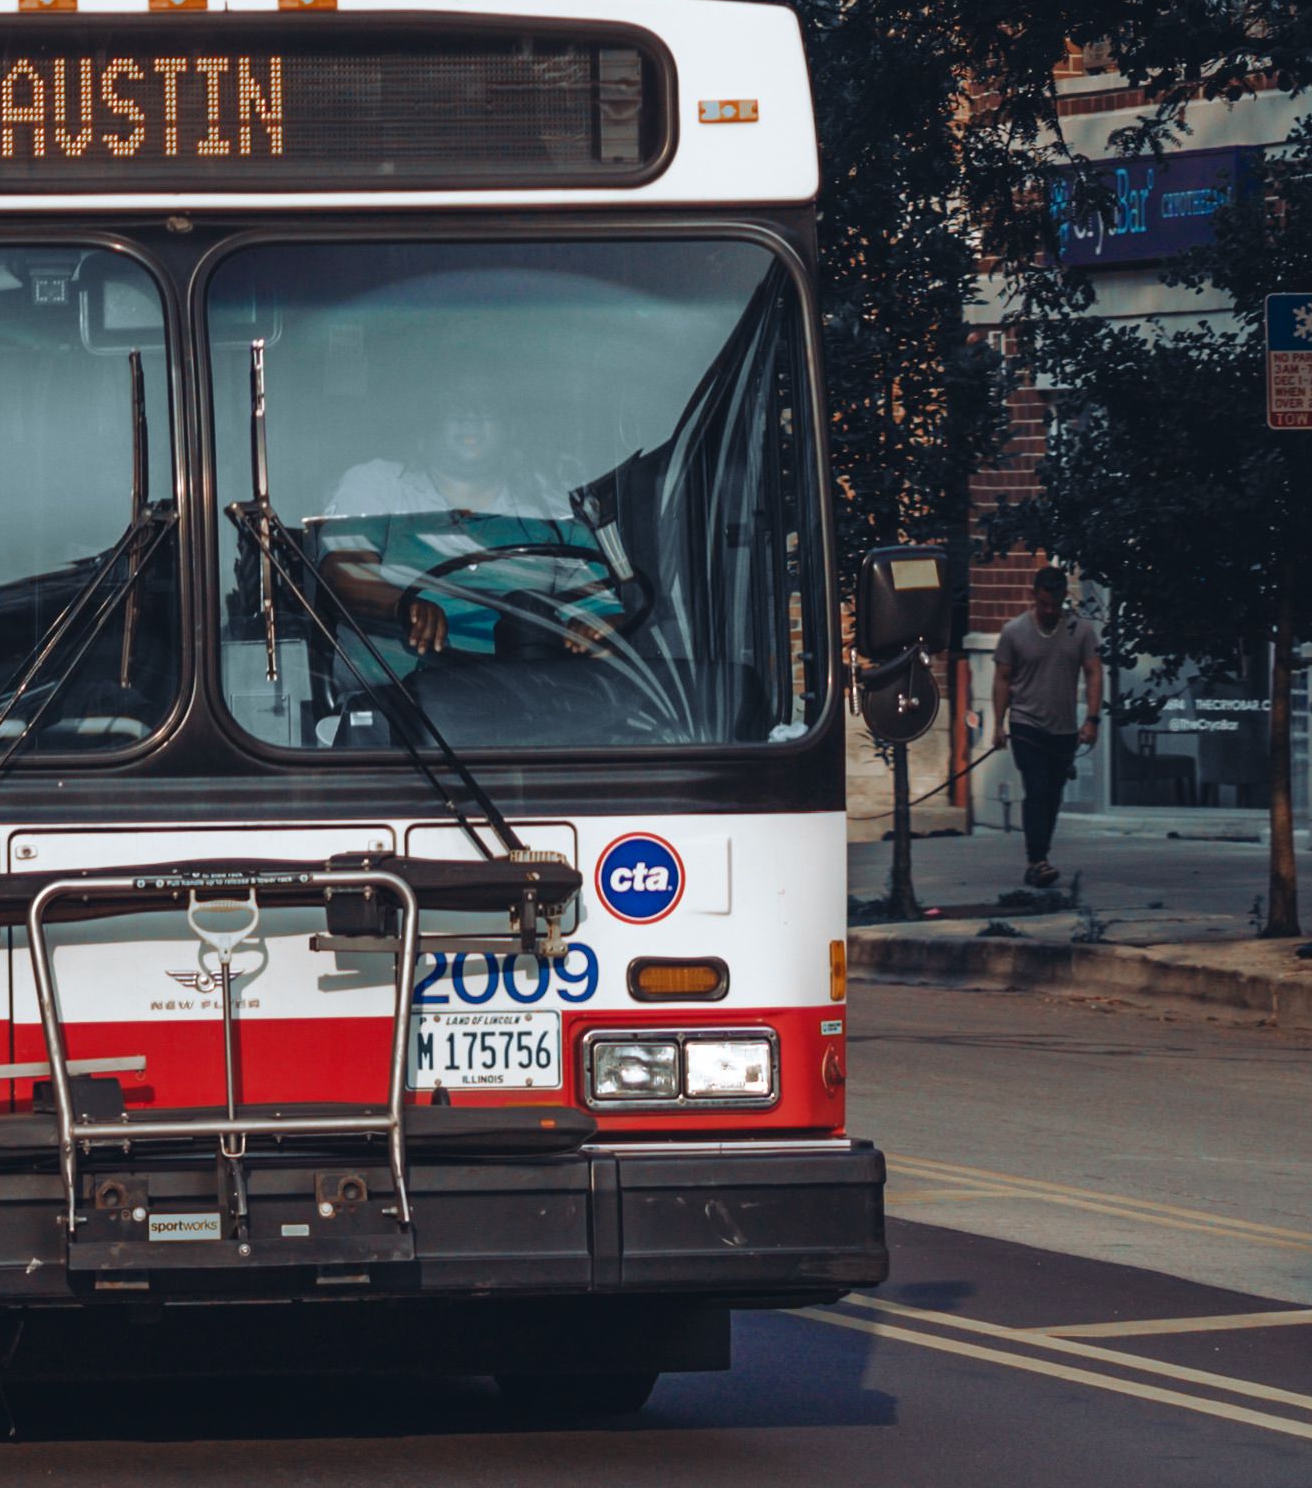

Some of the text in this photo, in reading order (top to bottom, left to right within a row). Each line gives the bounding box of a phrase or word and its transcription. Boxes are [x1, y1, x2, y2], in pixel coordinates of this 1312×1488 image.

[1, 57, 283, 157] AUSTIN
[1273, 353, 1289, 363] NO
[1273, 376, 1295, 386] DEC
[1274, 388, 1306, 397] WHEN
[1274, 399, 1304, 408] OVER
[1275, 414, 1308, 425] TOW
[411, 942, 599, 1005] 2009
[150, 998, 261, 1011] NEW FLER
[446, 1015, 521, 1026] LAND OF LINCOLN
[417, 1030, 552, 1071] M 175756
[461, 1074, 504, 1085] ILLINOIS
[150, 1219, 218, 1234] sportworks
